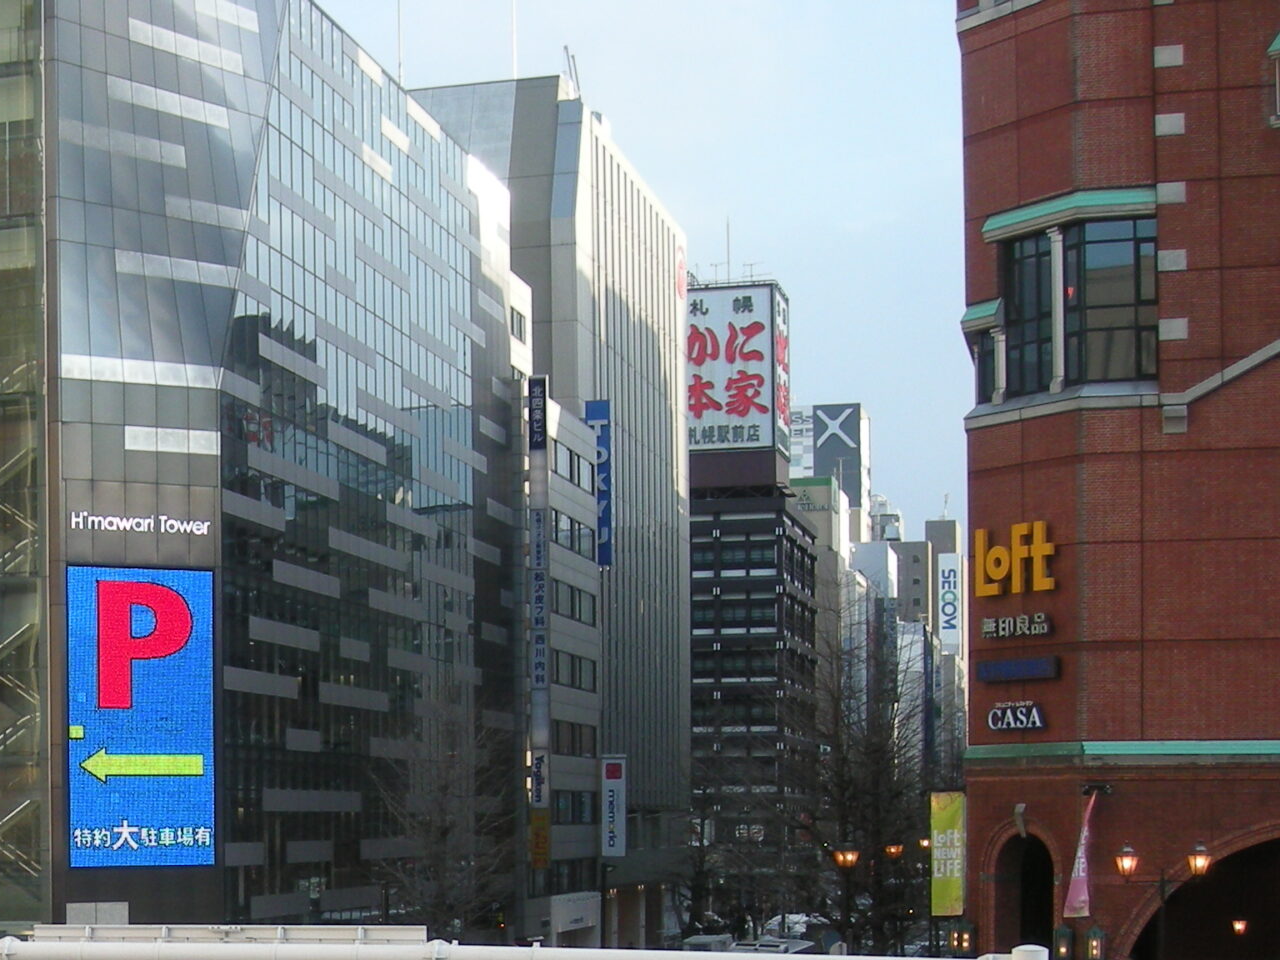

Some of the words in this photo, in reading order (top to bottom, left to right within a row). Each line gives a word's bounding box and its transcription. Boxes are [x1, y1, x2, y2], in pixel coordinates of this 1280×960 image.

[690, 296, 754, 316] 札幌
[687, 321, 765, 366] かに
[688, 370, 769, 419] 本家
[689, 424, 760, 445] 札幌駅前店
[158, 515, 211, 536] Tower
[941, 568, 957, 630] SECOM
[982, 613, 1048, 638] 無印良品
[97, 579, 193, 709] P
[988, 706, 1042, 729] CASA
[74, 820, 212, 851] 特約大駐車場有
